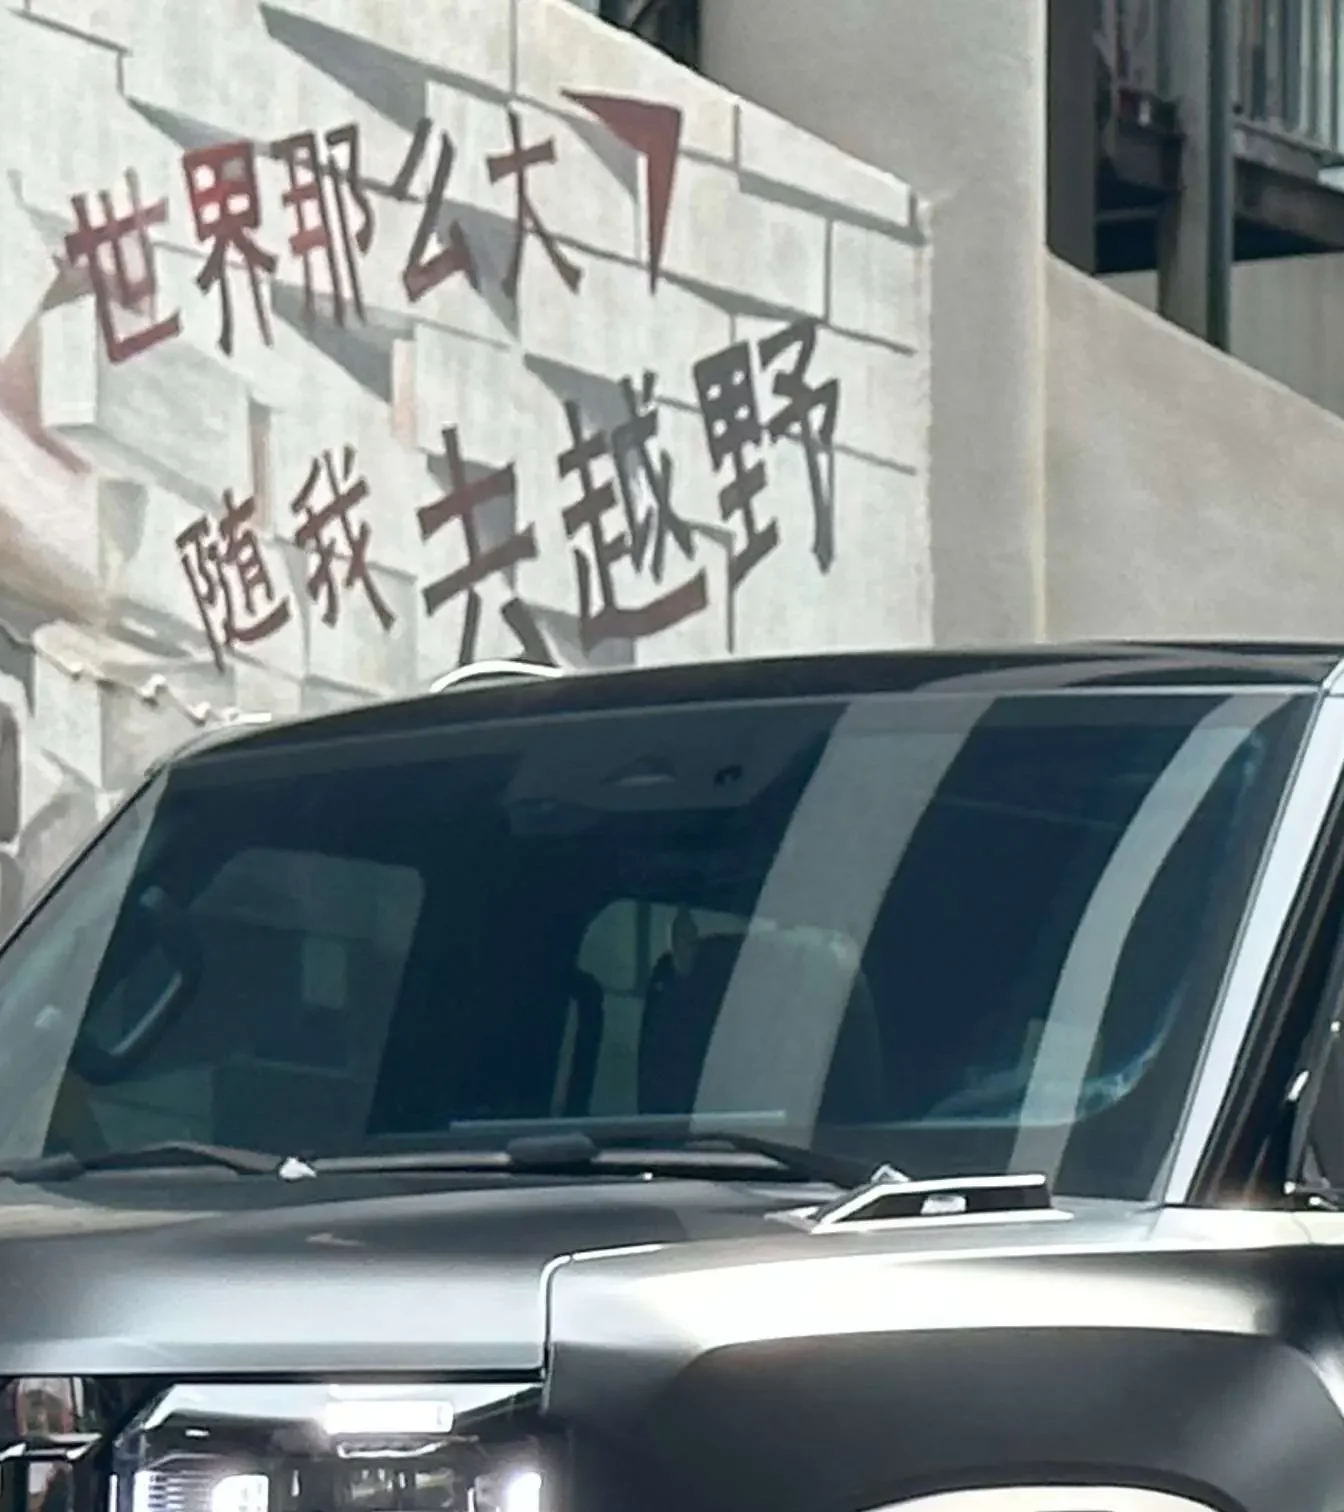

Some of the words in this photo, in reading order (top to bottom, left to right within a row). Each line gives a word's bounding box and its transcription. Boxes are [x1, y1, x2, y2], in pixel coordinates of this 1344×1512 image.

[63, 108, 584, 362] 世界那么大
[174, 318, 840, 674] 随我去越野
